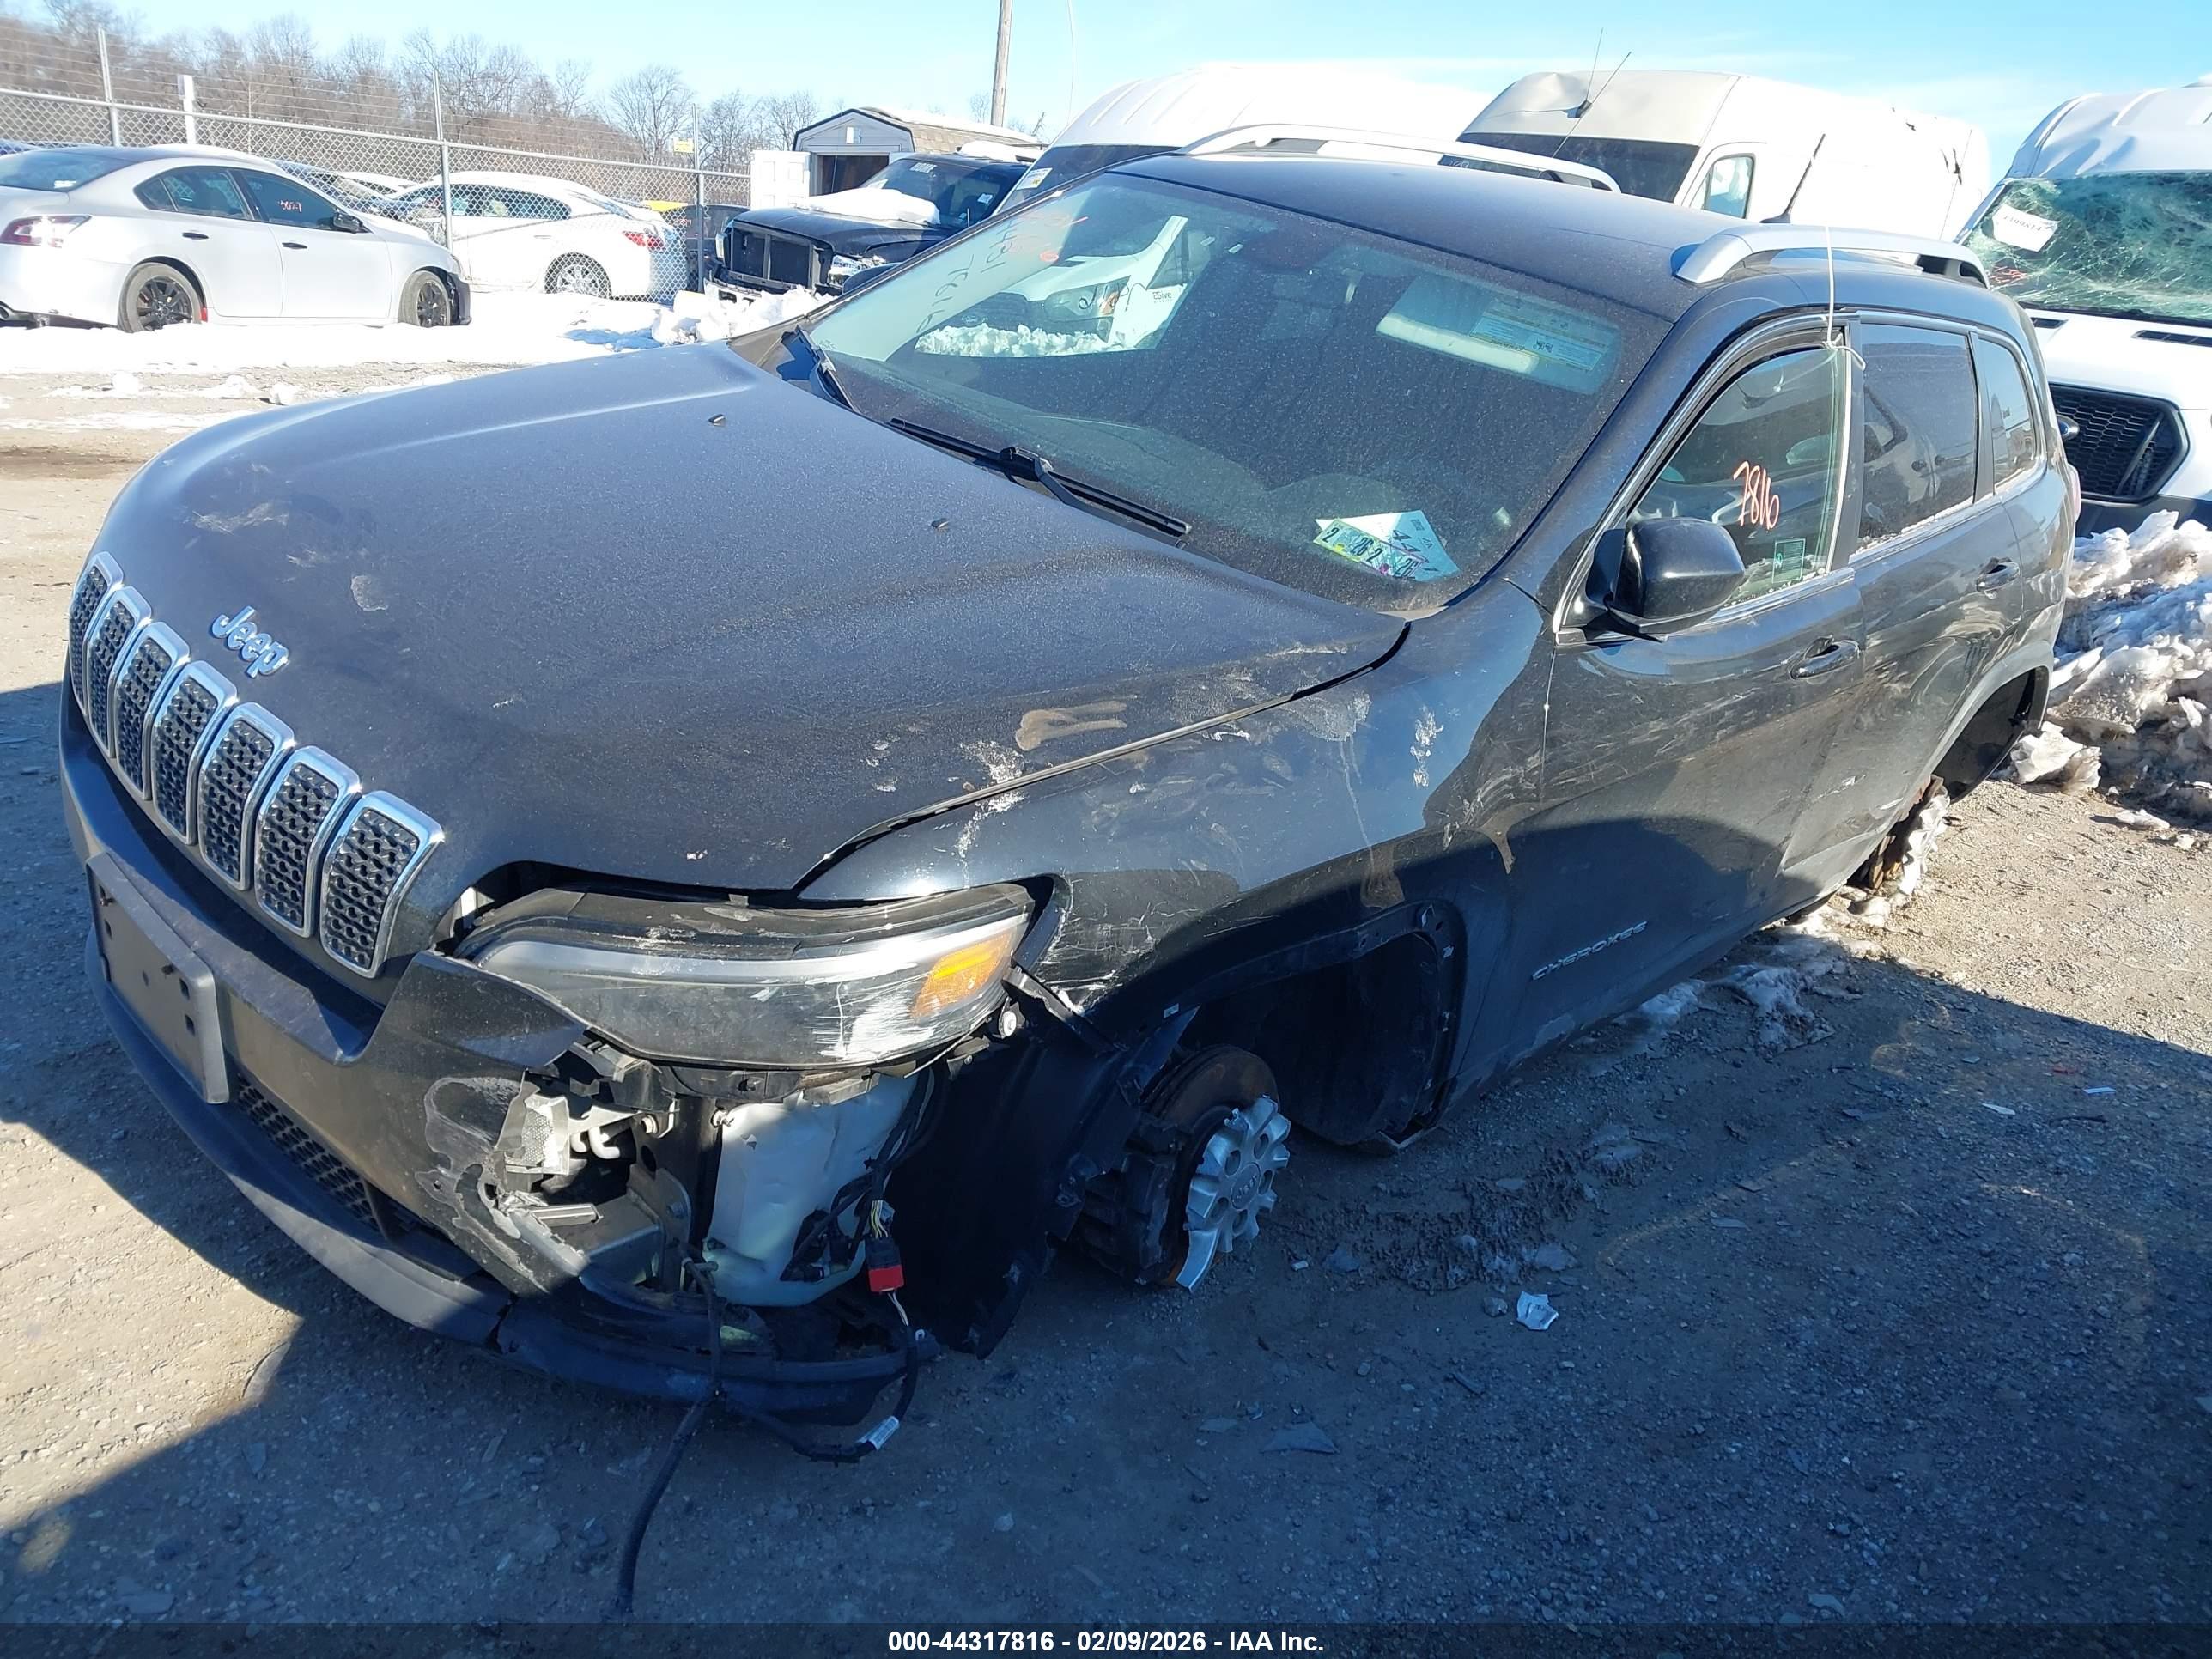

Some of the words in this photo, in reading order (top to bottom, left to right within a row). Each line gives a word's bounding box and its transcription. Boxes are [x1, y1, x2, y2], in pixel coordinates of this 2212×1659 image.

[1733, 460, 1780, 530] 7816
[1322, 527, 1340, 544] 2
[1351, 537, 1374, 556] 26
[1366, 547, 1383, 563] 2
[1395, 557, 1419, 577] 26
[211, 605, 290, 678] Jeep
[1532, 920, 1648, 981] CHEROKEE
